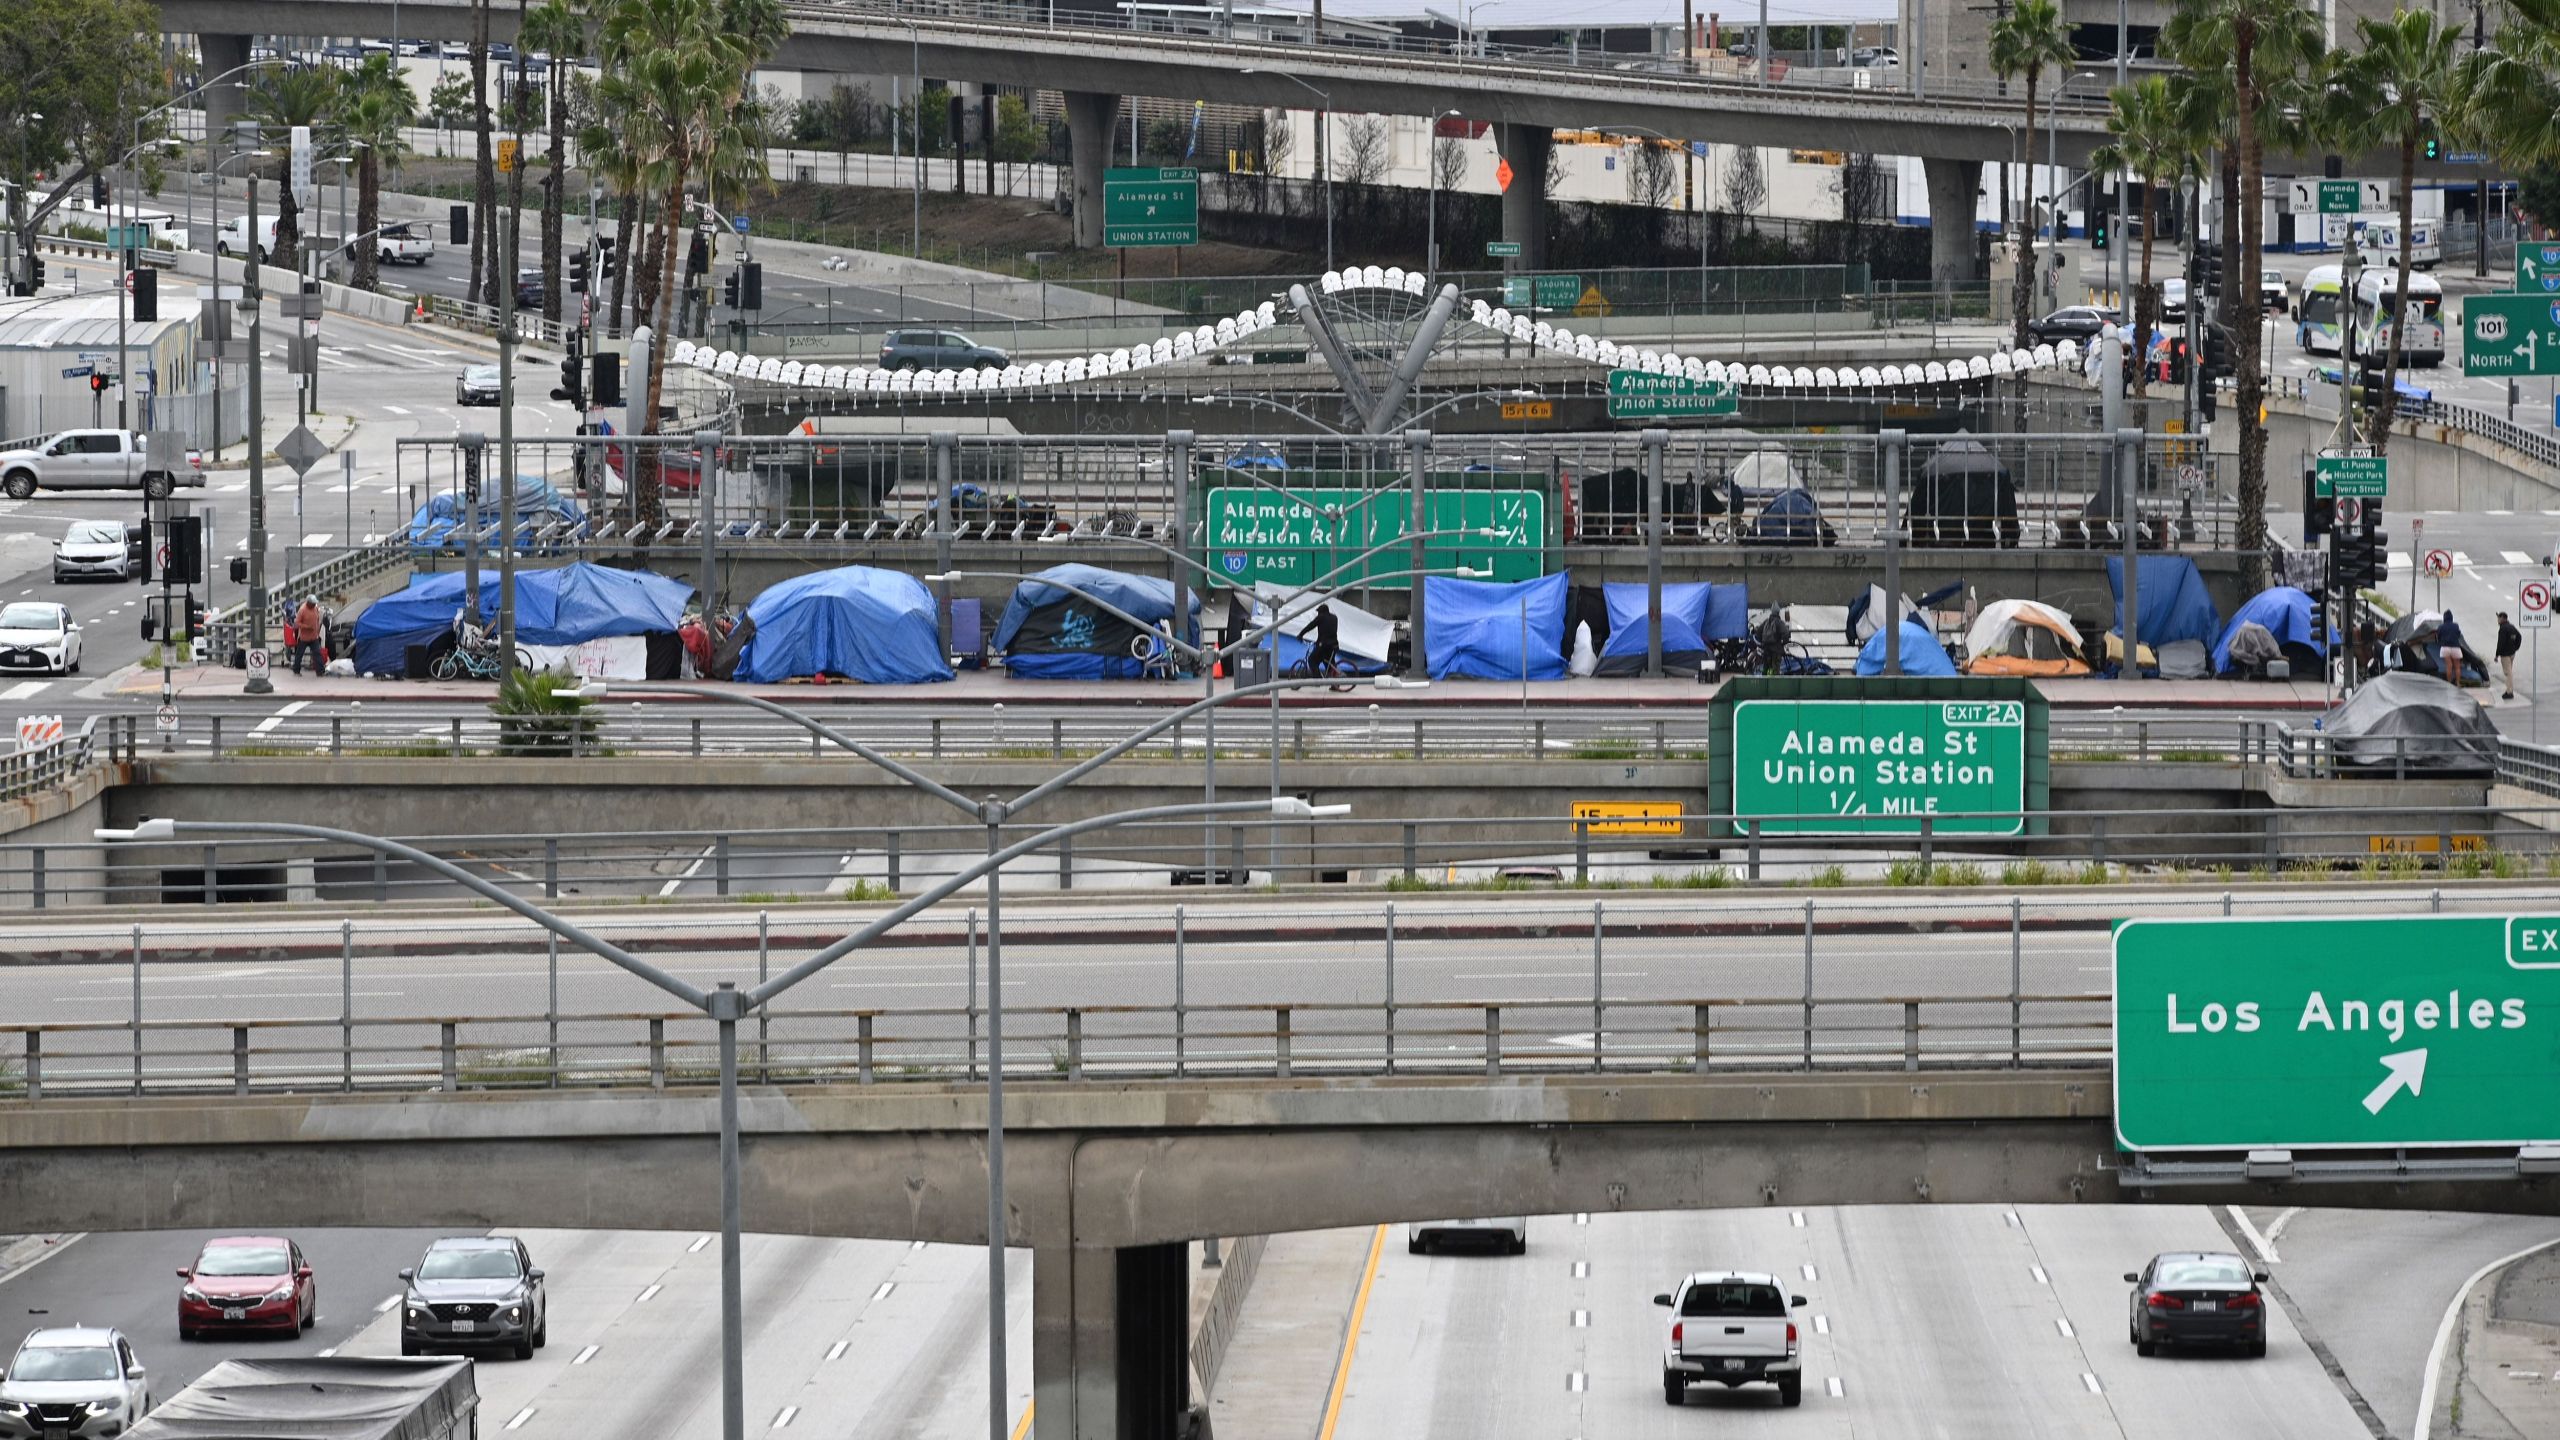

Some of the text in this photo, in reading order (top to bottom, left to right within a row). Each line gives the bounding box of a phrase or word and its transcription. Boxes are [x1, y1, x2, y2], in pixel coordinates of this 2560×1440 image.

[1181, 170, 1193, 178] 2A
[1118, 191, 1184, 201] Alameda St
[2335, 193, 2343, 202] St
[1112, 231, 1190, 241] UNION STATION
[2547, 252, 2557, 260] 10
[2548, 280, 2555, 288] 5
[2481, 321, 2501, 334] 101
[2470, 354, 2512, 367] NORTH
[1621, 376, 1686, 390] Alameda
[1662, 397, 1716, 409] Station
[1505, 405, 1516, 416] 15
[1531, 405, 1538, 415] 6
[2341, 461, 2376, 469] El Pueblo
[2334, 470, 2384, 479] Historic Park
[2359, 484, 2383, 493] Street
[1223, 502, 1312, 518] Alameda
[1222, 527, 1300, 544] Mission
[1229, 557, 1241, 570] 10
[1256, 556, 1297, 569] EAST
[2523, 613, 2547, 622] ON RED
[1947, 705, 2019, 723] EXIT 2A
[1781, 730, 1978, 755] Alameda St
[1764, 759, 1994, 785] Union Station
[1830, 790, 1939, 816] 1/4 MILE
[1580, 809, 1601, 826] 15
[1606, 814, 1624, 827] FT
[2380, 837, 2395, 852] 14
[2166, 988, 2527, 1043] Los Angeles
